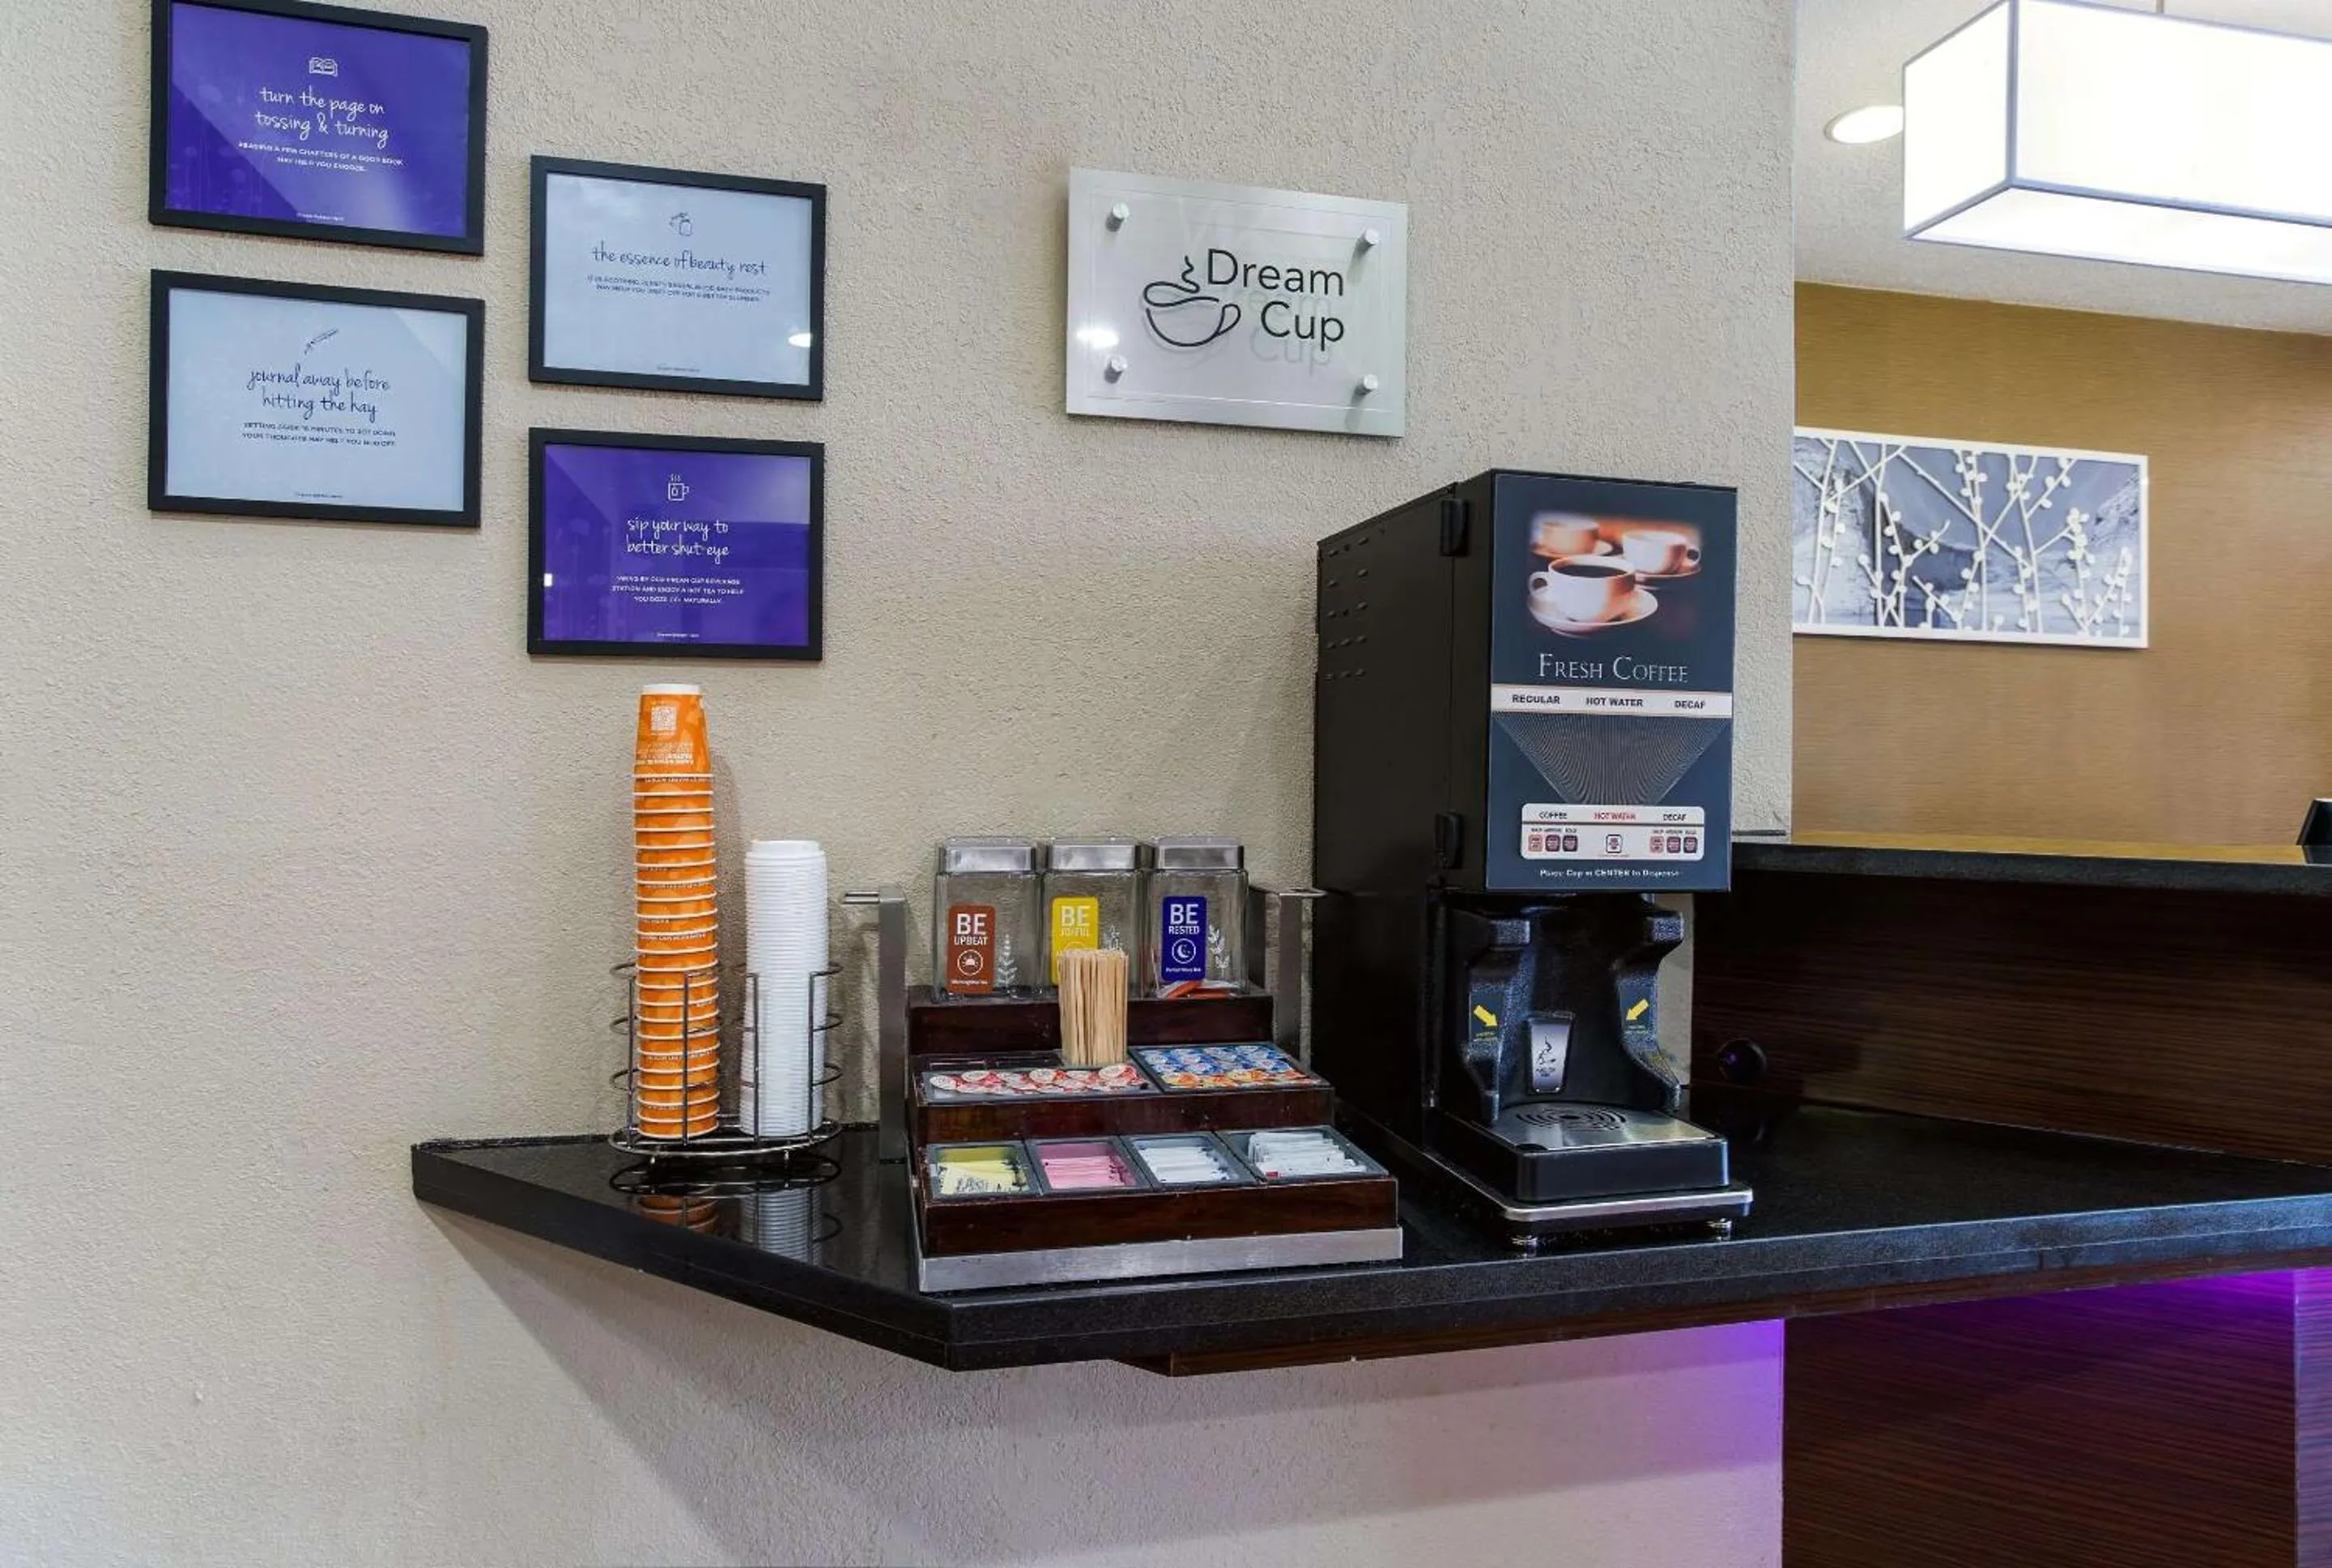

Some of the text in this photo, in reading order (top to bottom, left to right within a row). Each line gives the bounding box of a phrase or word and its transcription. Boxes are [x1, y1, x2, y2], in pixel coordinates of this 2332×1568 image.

[260, 85, 385, 121] turn the page on
[255, 110, 389, 149] tossing & turning
[591, 240, 768, 280] the essence of beauty rest
[1207, 249, 1343, 296] Dream
[1260, 300, 1344, 351] Cup
[247, 363, 390, 396] journal away before
[262, 385, 377, 423] hitting the hay
[627, 516, 729, 541] sip your way to
[626, 533, 730, 564] better shut eye
[1538, 652, 1689, 683] FRESH COFFEE
[1512, 694, 1560, 705] REGULAR
[1586, 697, 1643, 708] HOT WATER
[1675, 699, 1706, 709] DECAF
[1538, 811, 1568, 820] COFFEE
[1663, 813, 1687, 821] DECAF
[957, 913, 987, 935] BE
[1062, 905, 1091, 926] BE
[1170, 903, 1198, 924] BE
[954, 936, 988, 945] UPBEAT
[1168, 925, 1200, 935] RESTED
